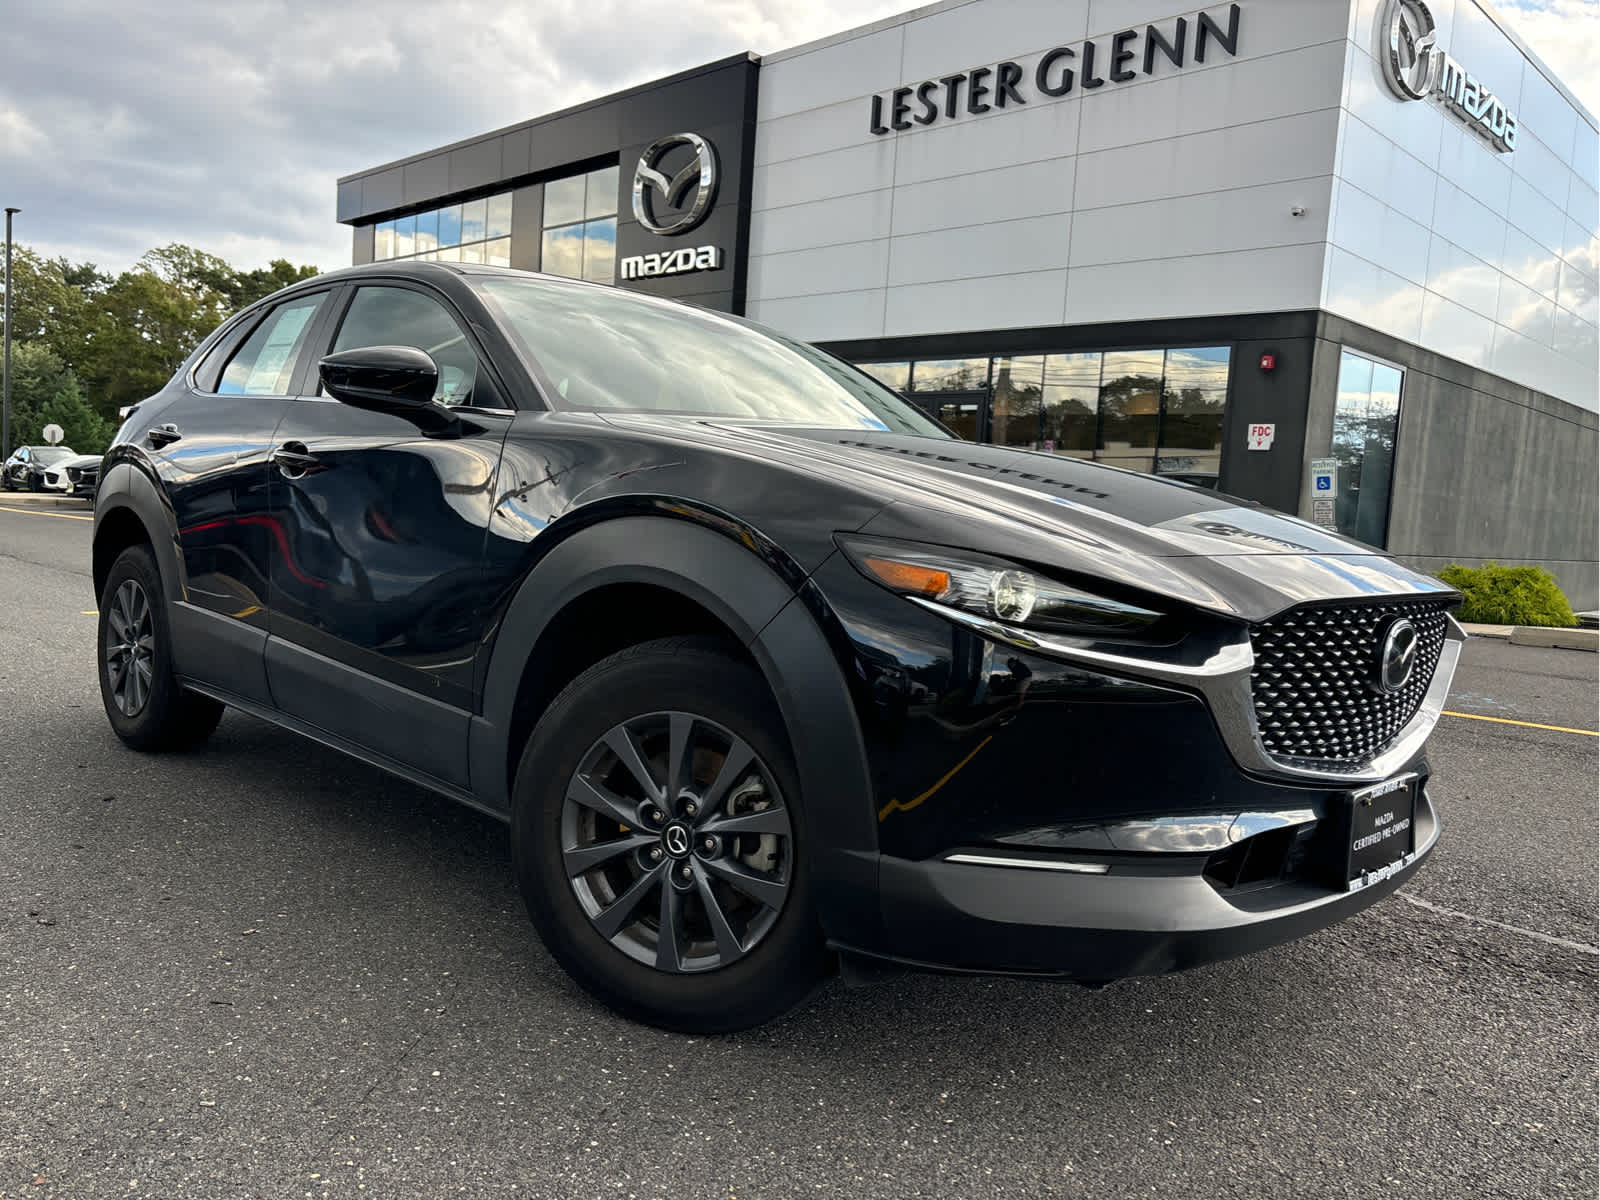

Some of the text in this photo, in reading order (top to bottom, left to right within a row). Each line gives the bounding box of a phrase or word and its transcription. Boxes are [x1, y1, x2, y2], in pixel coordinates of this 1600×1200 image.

[870, 4, 1240, 135] LESTER GLENN
[620, 245, 719, 280] mazda
[1251, 425, 1272, 437] FDC
[1353, 819, 1410, 851] CERTIFIED PRE-OWNED
[1375, 811, 1394, 827] MAZDA
